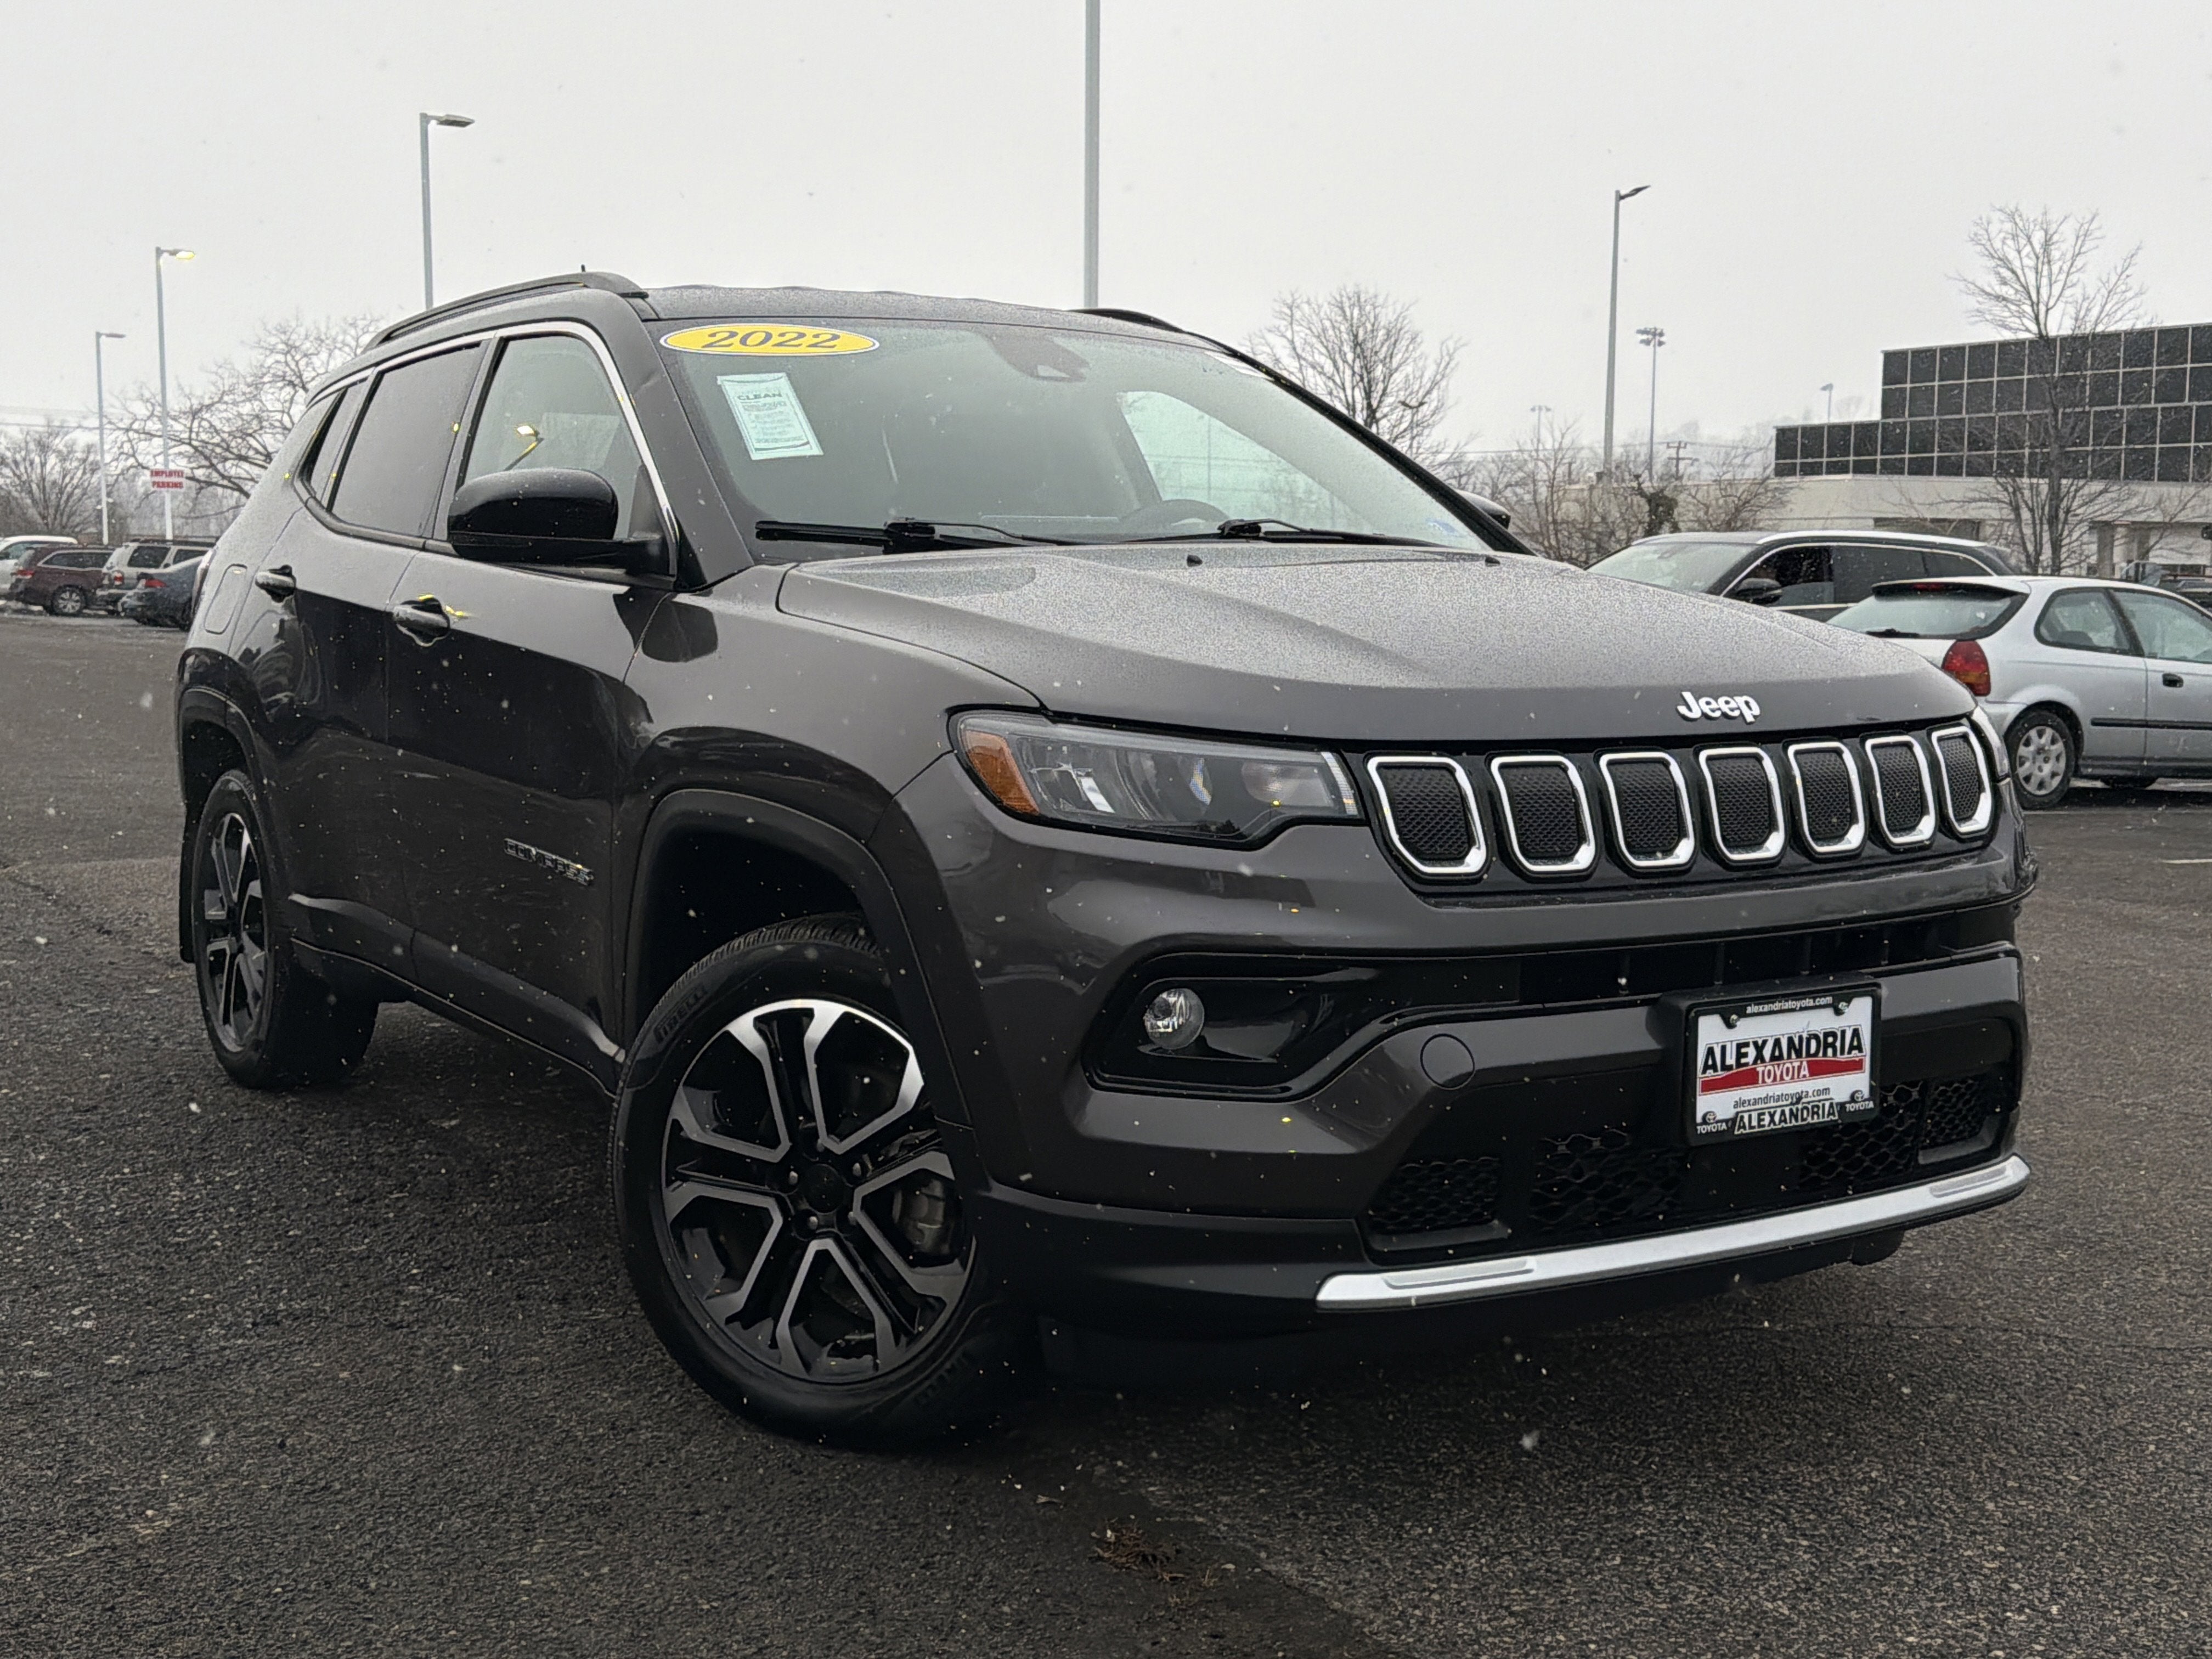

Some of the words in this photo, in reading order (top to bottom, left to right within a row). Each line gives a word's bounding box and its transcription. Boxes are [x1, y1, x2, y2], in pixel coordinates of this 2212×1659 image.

[701, 330, 842, 349] 2022
[737, 392, 783, 400] CLEAN
[1677, 691, 1761, 724] Jeep
[1746, 996, 1833, 1014] alexandriatoyota.com
[1701, 1027, 1864, 1075] ALEXANDRIA
[1756, 1061, 1809, 1084] TOYOTA
[1733, 1087, 1831, 1109] alexandriatoyota.com
[1845, 1101, 1874, 1111] TOYOTA
[1697, 1122, 1727, 1134] TOYOTA
[1735, 1102, 1838, 1134] ALEXANDRIA
